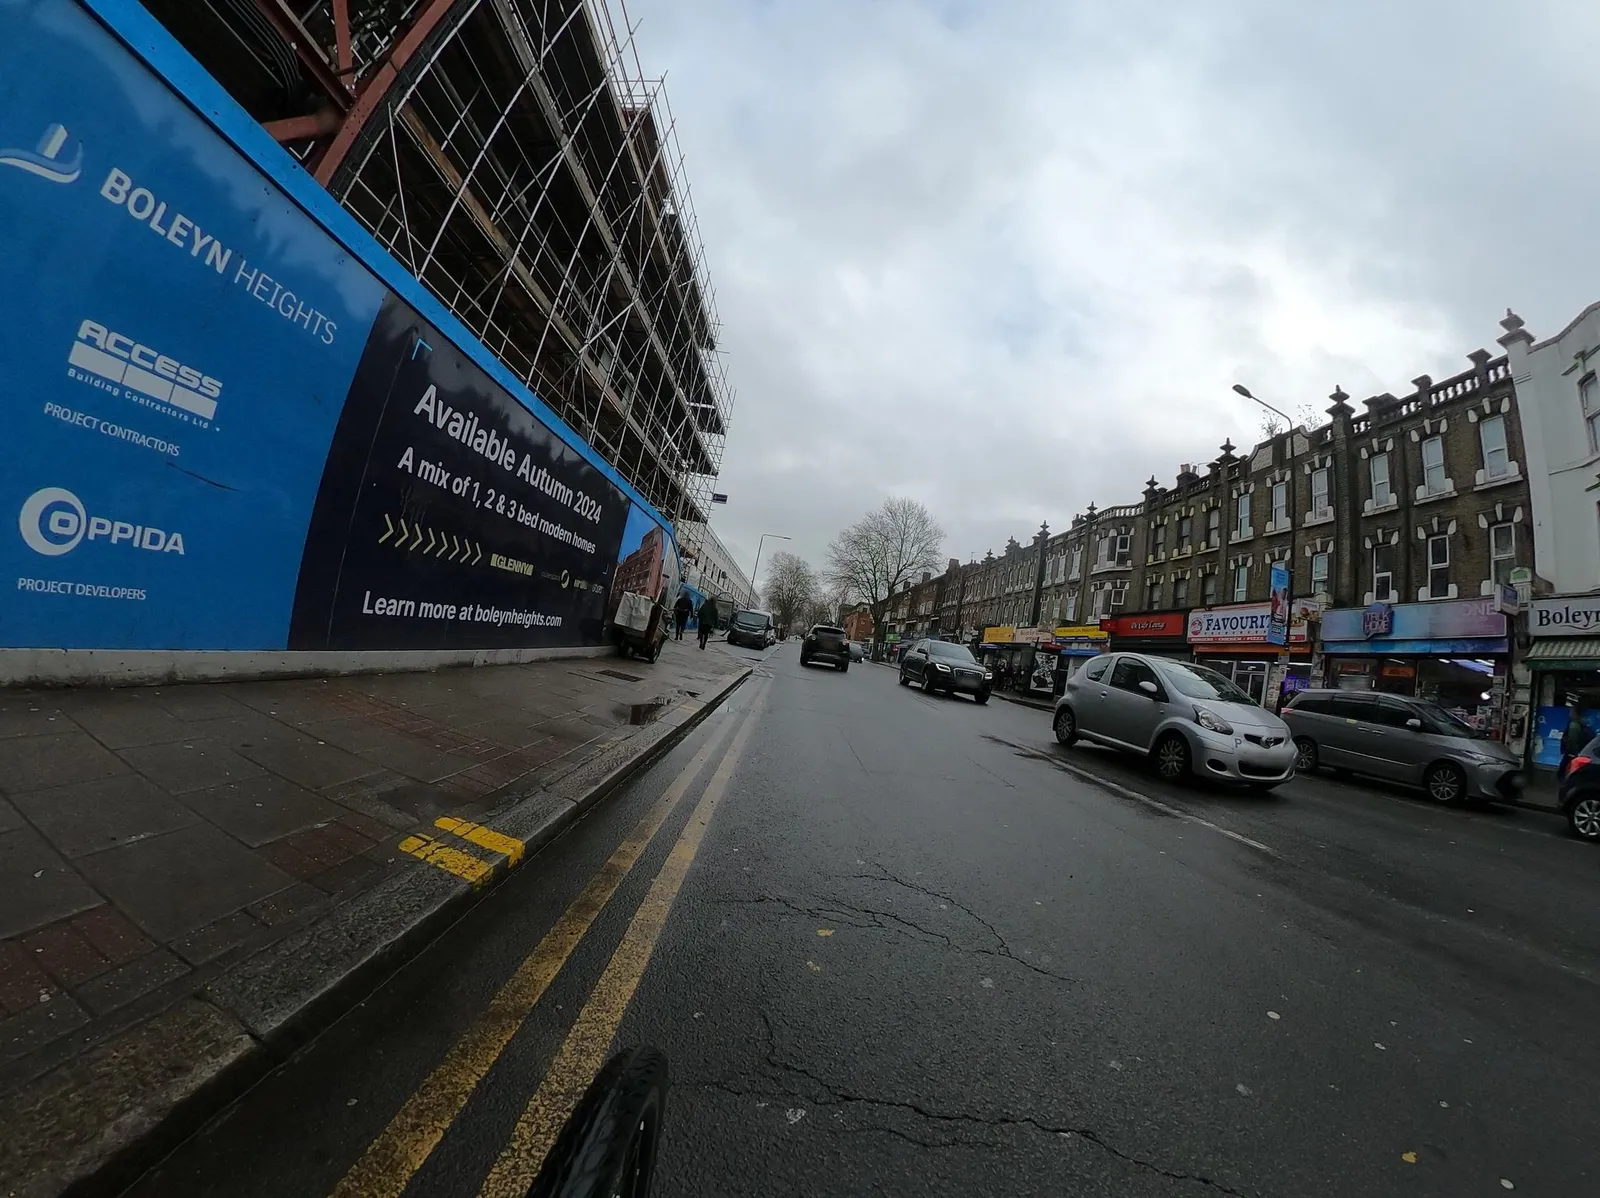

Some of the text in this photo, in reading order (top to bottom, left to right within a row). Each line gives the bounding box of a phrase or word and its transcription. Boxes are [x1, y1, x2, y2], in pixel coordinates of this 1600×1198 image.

[100, 167, 337, 344] BOLEYN HEIGHTS
[77, 319, 223, 398] ACCESS
[68, 369, 119, 396] Building
[125, 390, 188, 422] Contractors
[44, 402, 180, 456] PROJECT CONTRACTORS
[413, 383, 602, 525] Available Autumn 2024
[397, 446, 596, 554] A mix of 1, 2 & 3 bed modern homes
[49, 510, 185, 555] OPPIDA
[17, 577, 147, 600] PROJECT DEVELOPERS
[497, 555, 530, 575] GLENNY
[363, 590, 562, 629] Learn more at boleynheights.com
